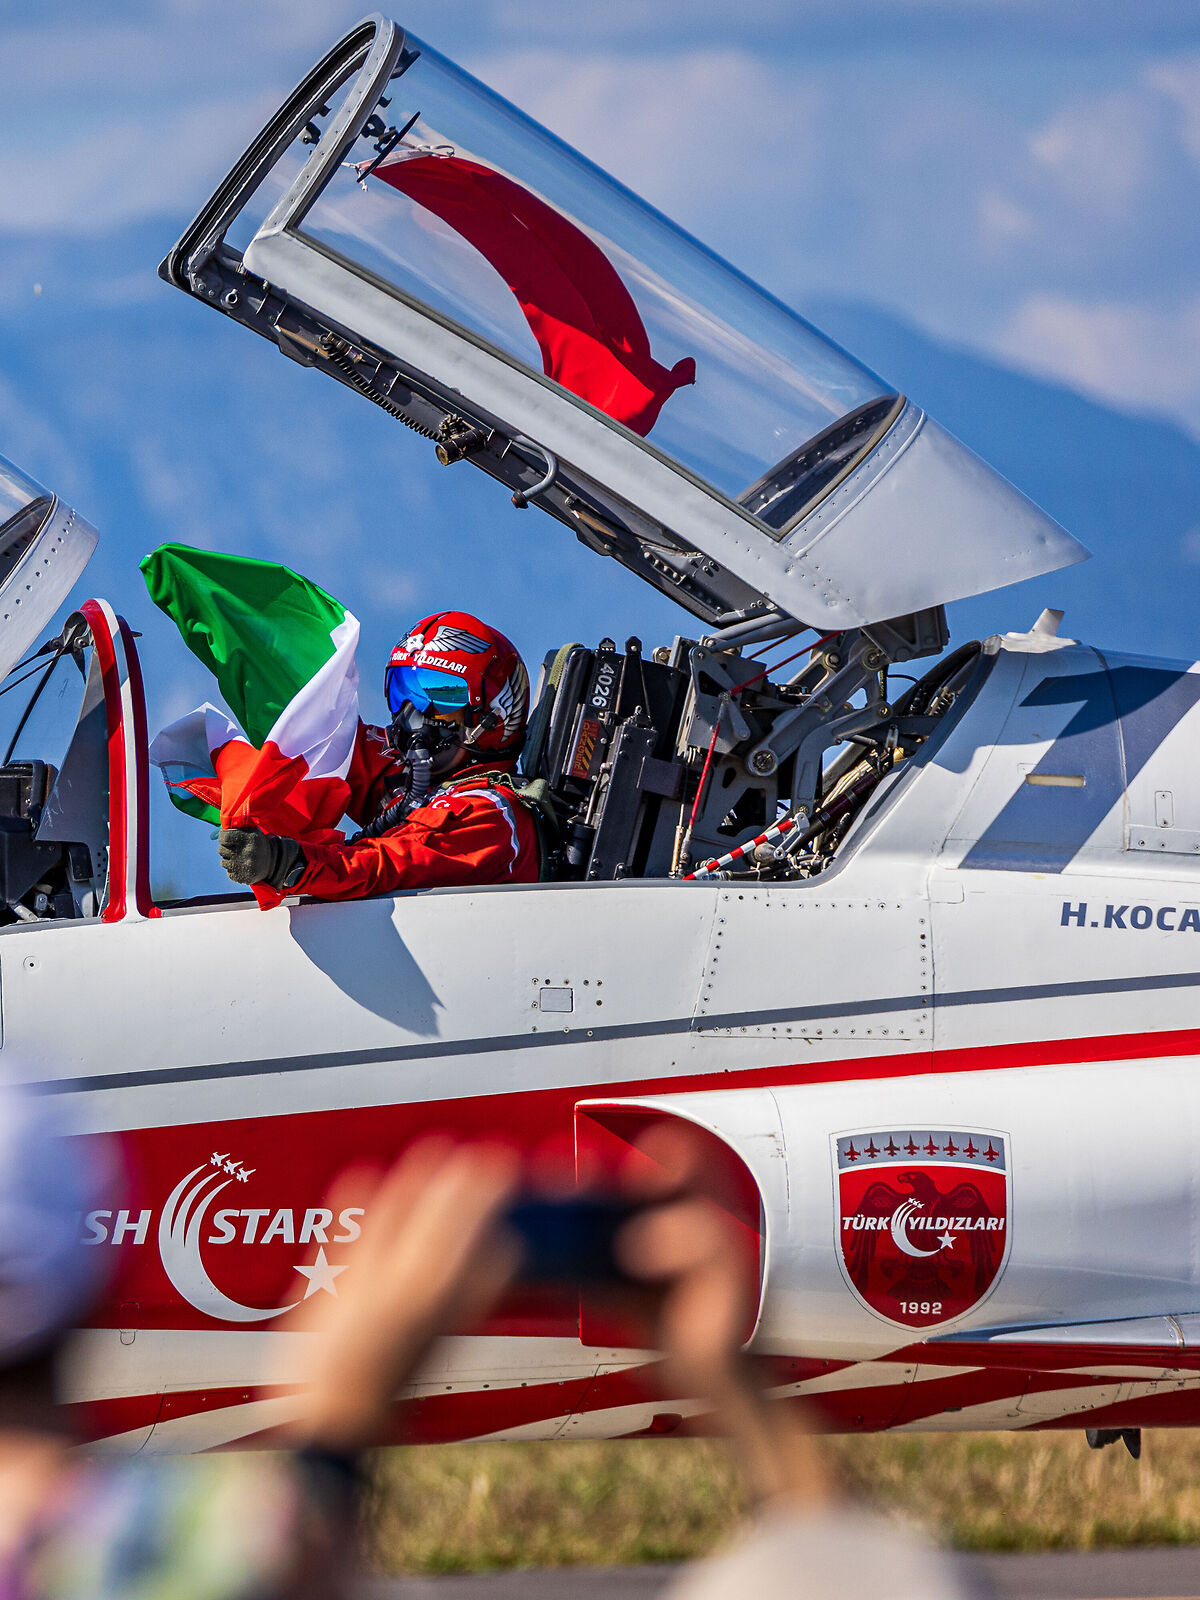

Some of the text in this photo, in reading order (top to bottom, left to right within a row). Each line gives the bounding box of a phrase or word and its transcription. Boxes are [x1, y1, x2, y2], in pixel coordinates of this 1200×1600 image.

[592, 662, 615, 708] 4026
[1060, 901, 1200, 932] H.KOCA
[75, 1208, 365, 1245] SH STARS
[842, 1214, 1005, 1231] TÜRK YILDIZLARI
[900, 1302, 942, 1315] 1992
